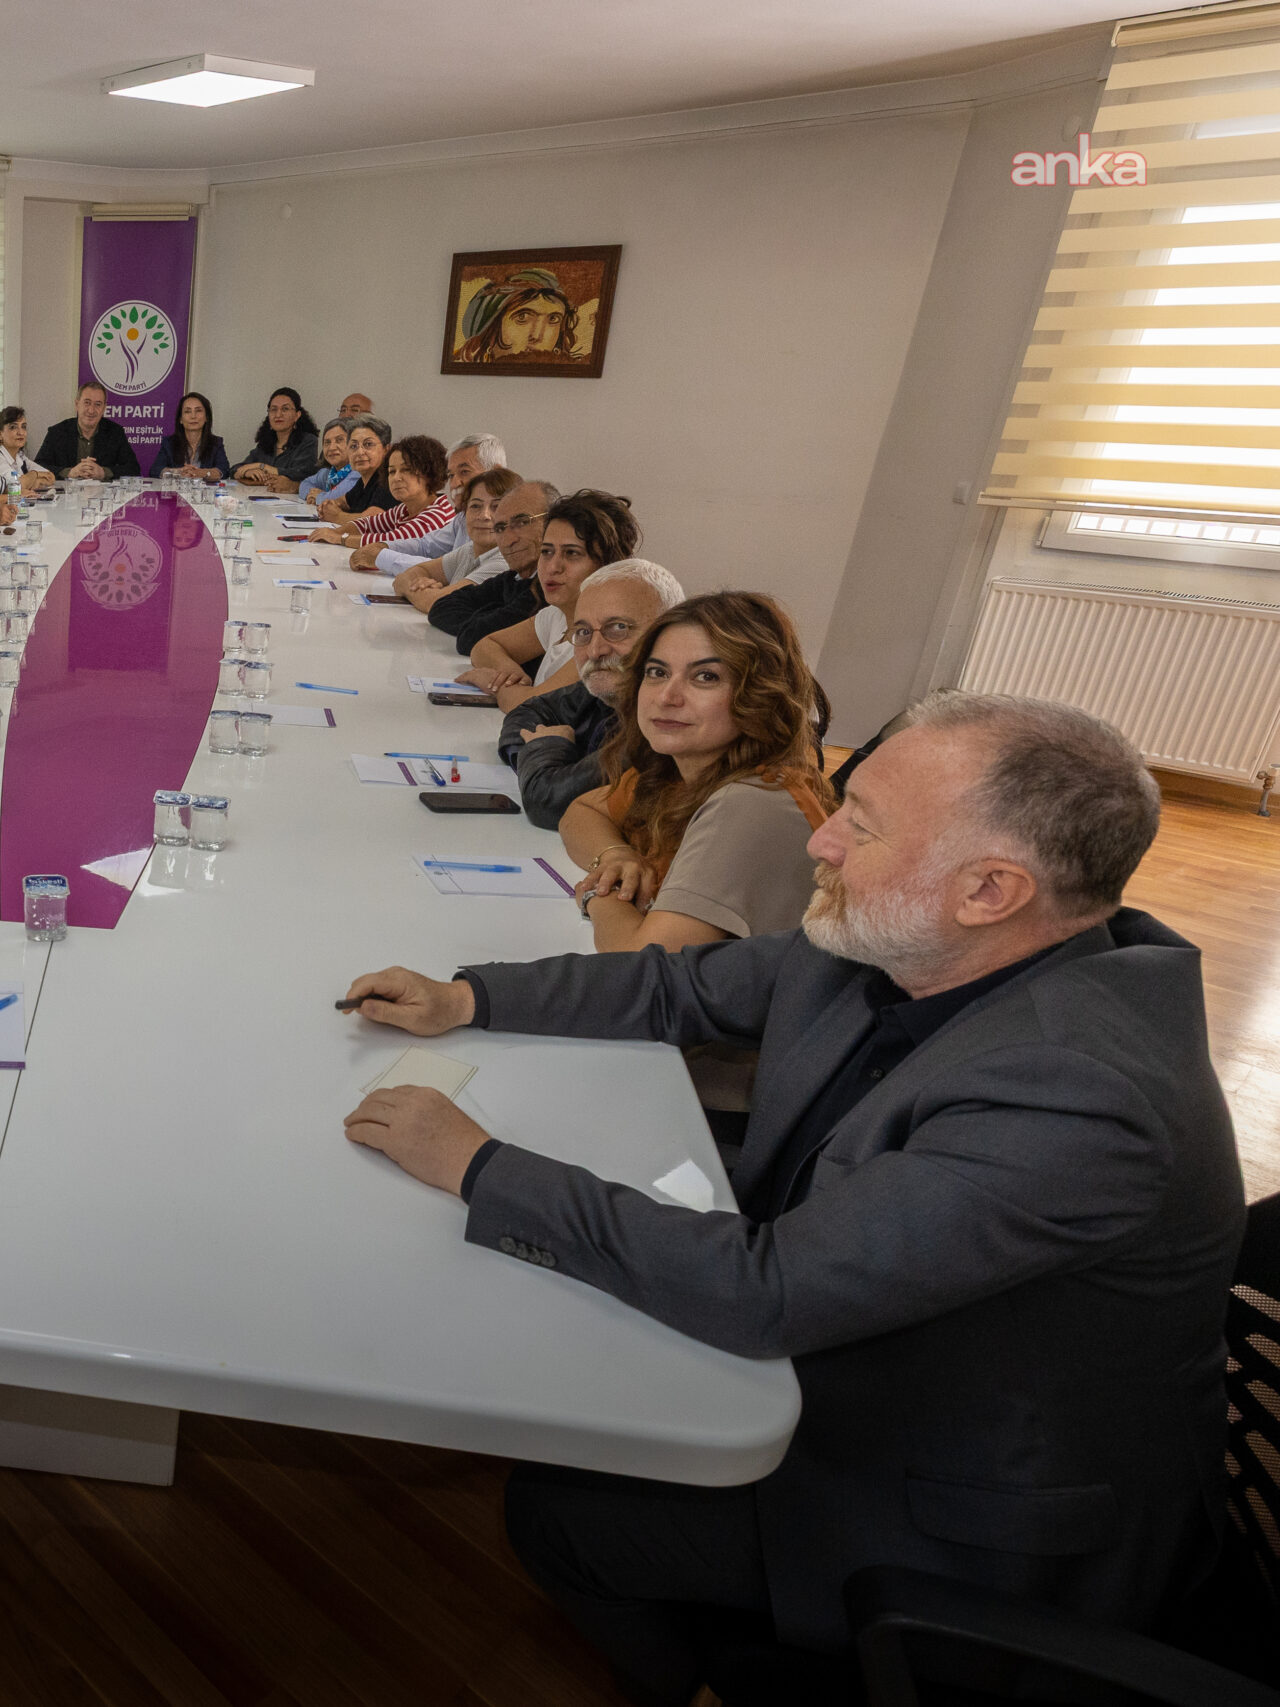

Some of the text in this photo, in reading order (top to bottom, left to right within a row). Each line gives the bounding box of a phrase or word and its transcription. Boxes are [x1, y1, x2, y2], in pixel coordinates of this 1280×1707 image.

[114, 382, 127, 391] DEM
[103, 402, 164, 418] EM PARTİ
[140, 435, 162, 444] PARTİ
